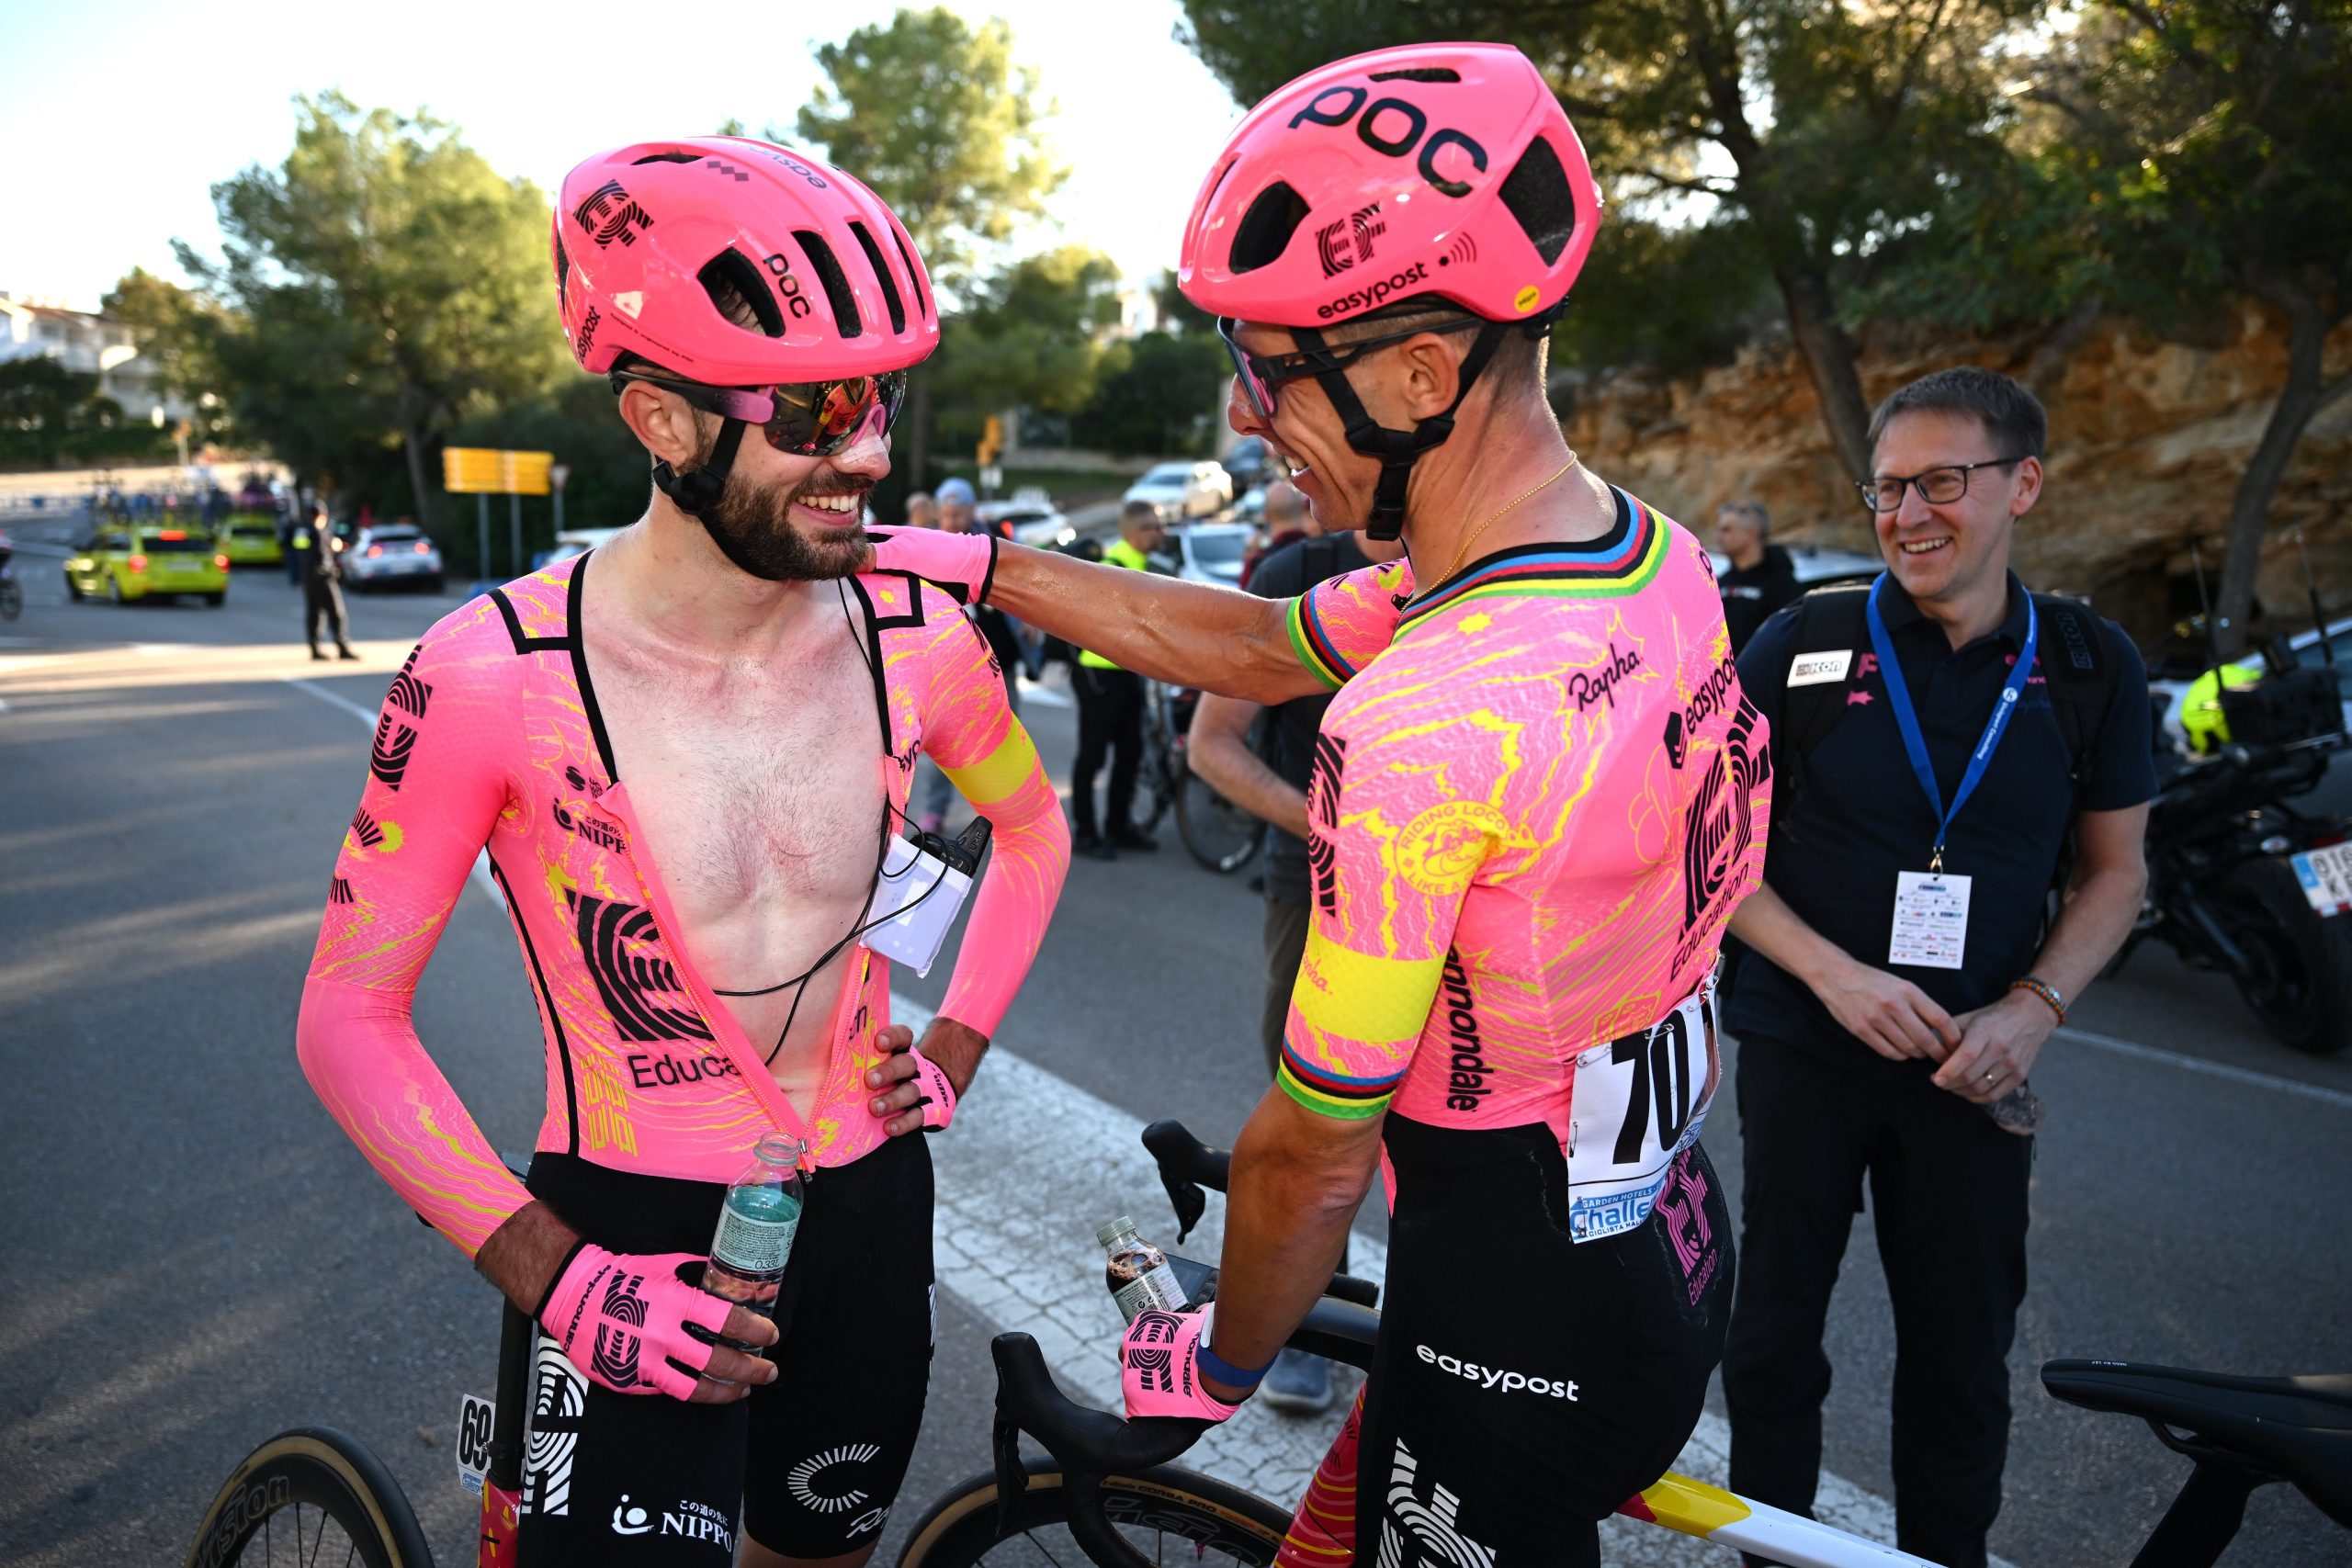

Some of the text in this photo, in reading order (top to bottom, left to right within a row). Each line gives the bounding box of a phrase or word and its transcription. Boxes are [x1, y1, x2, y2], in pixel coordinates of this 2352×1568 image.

[1317, 261, 1429, 320] easypost
[576, 305, 602, 365] asypost
[1685, 649, 1736, 735] easypos
[1400, 804, 1507, 851] RIDING LOCO
[1407, 873, 1446, 894] LIKE
[1668, 863, 1750, 983] Education
[1442, 944, 1495, 1112] annondale
[628, 1053, 742, 1089] Educa
[1611, 1010, 1690, 1165] 70
[1569, 1198, 1654, 1240] Challe
[1582, 1188, 1653, 1208] GARDEN HOTELS
[1589, 1224, 1624, 1237] CICLISTA
[1687, 1248, 1718, 1307] Education
[563, 1264, 612, 1353] cannondale
[1416, 1344, 1579, 1402] easypost
[460, 1399, 493, 1472] 69
[1137, 1484, 1186, 1503] CORSA
[1187, 1498, 1217, 1514] PRO
[659, 1511, 733, 1553] NIPPO
